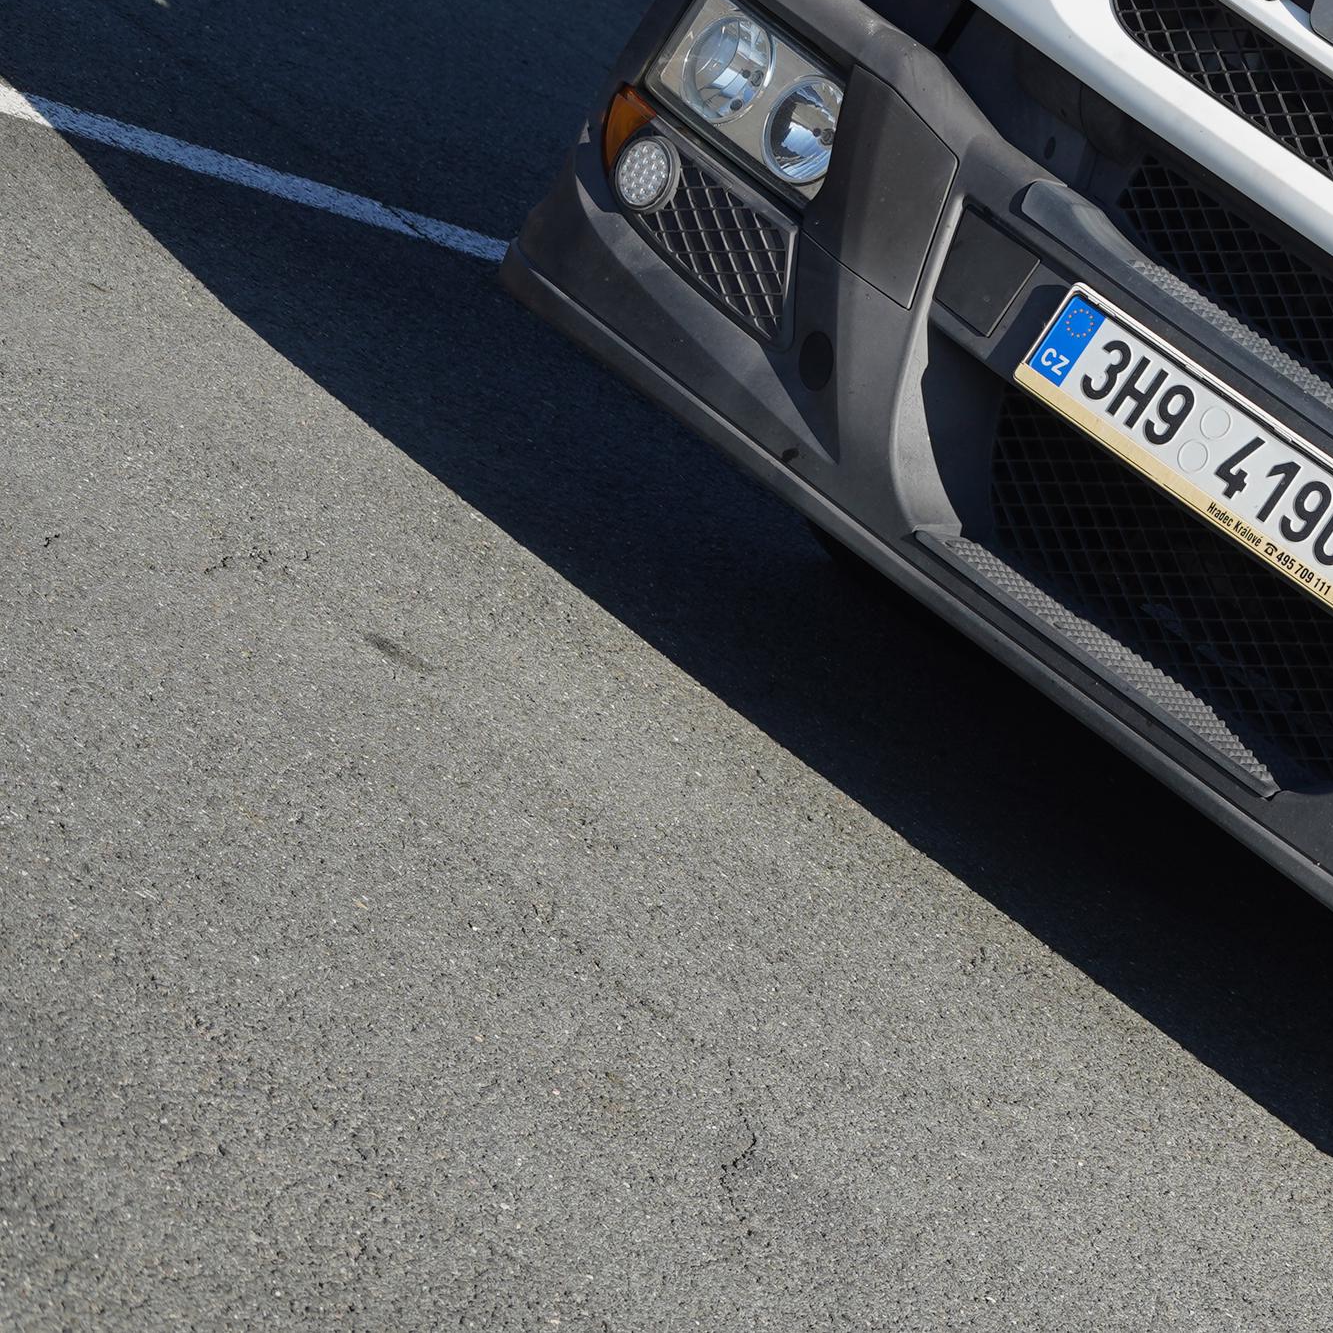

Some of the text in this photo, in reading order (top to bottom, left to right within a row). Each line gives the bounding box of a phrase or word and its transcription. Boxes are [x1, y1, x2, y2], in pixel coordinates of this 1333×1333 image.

[1040, 347, 1070, 377] CZ
[1079, 339, 1196, 445] 3H9
[1206, 501, 1332, 596] Hradec Králové 495 709 111
